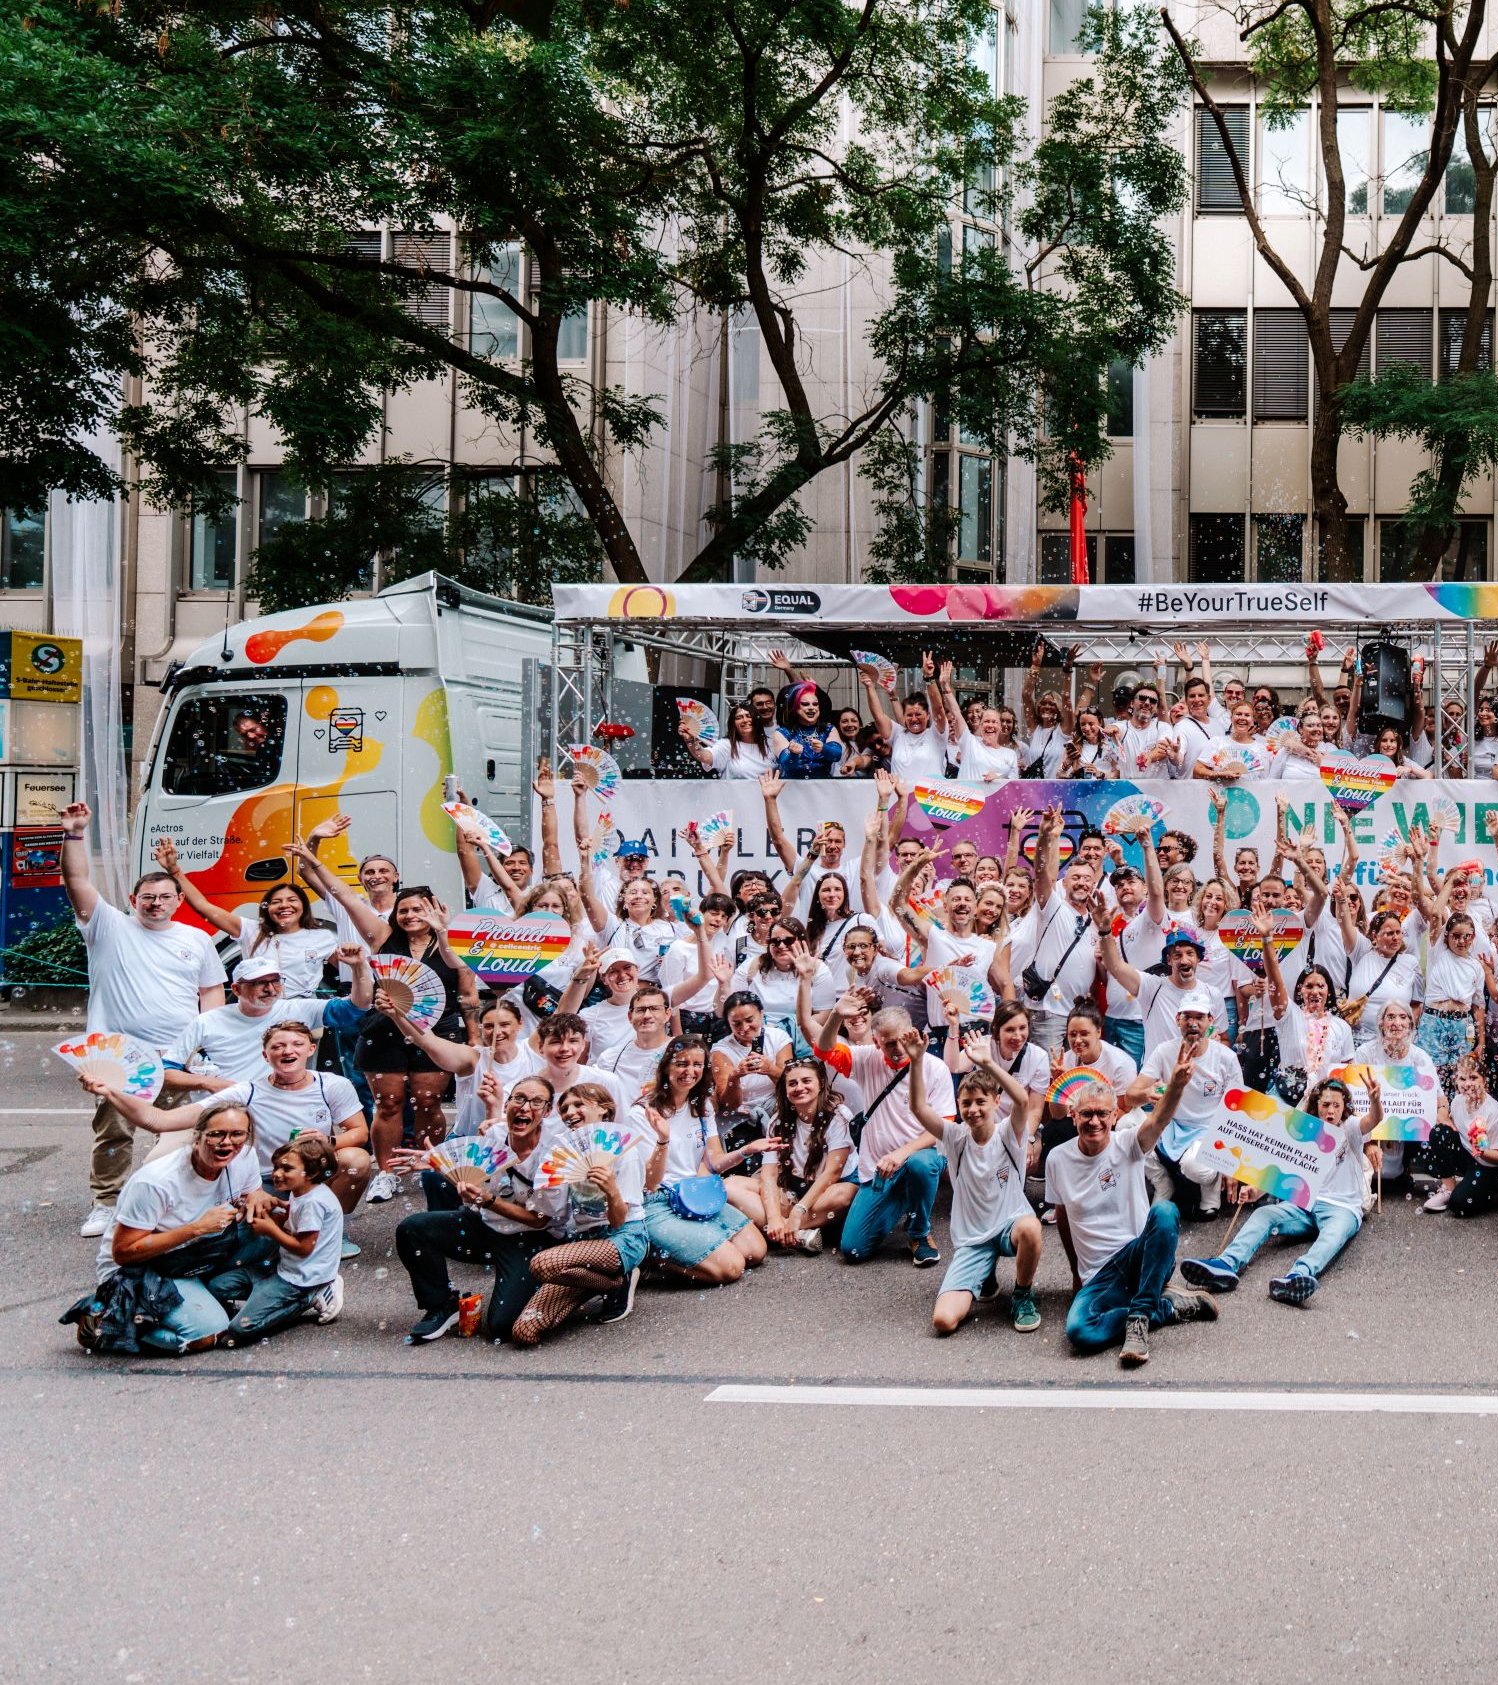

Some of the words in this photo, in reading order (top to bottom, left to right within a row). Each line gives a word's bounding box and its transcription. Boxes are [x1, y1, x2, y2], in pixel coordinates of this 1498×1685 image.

[774, 594, 814, 605] EQUAL
[1138, 591, 1328, 612] #BeYourTrueSelf
[16, 677, 78, 687] S-Bahn-Haltestelle
[1333, 758, 1384, 779] Proud
[24, 783, 66, 792] Feuersee
[1332, 774, 1342, 786] &
[1336, 784, 1377, 802] Loud
[927, 805, 966, 821] Loud
[150, 824, 184, 833] eActros
[1285, 802, 1376, 844] NIE
[175, 836, 190, 846] auf
[191, 836, 207, 845] der
[209, 835, 243, 845] Straße.
[471, 918, 551, 943] Proud
[1234, 917, 1287, 935] Prod
[469, 940, 485, 955] &
[497, 943, 542, 951] cellcentric
[1235, 936, 1245, 948] &
[1243, 942, 1285, 960] Lod
[477, 950, 542, 973] Loud
[1407, 1099, 1422, 1107] FÜR
[1226, 1119, 1248, 1133] HASS
[1248, 1128, 1264, 1140] HAT
[1265, 1135, 1293, 1153] KEINEN
[1294, 1148, 1318, 1163] PLATZ
[1217, 1125, 1234, 1136] AUF
[1234, 1133, 1270, 1152] UNSERER
[1270, 1148, 1320, 1174] LADEFLÄCHE
